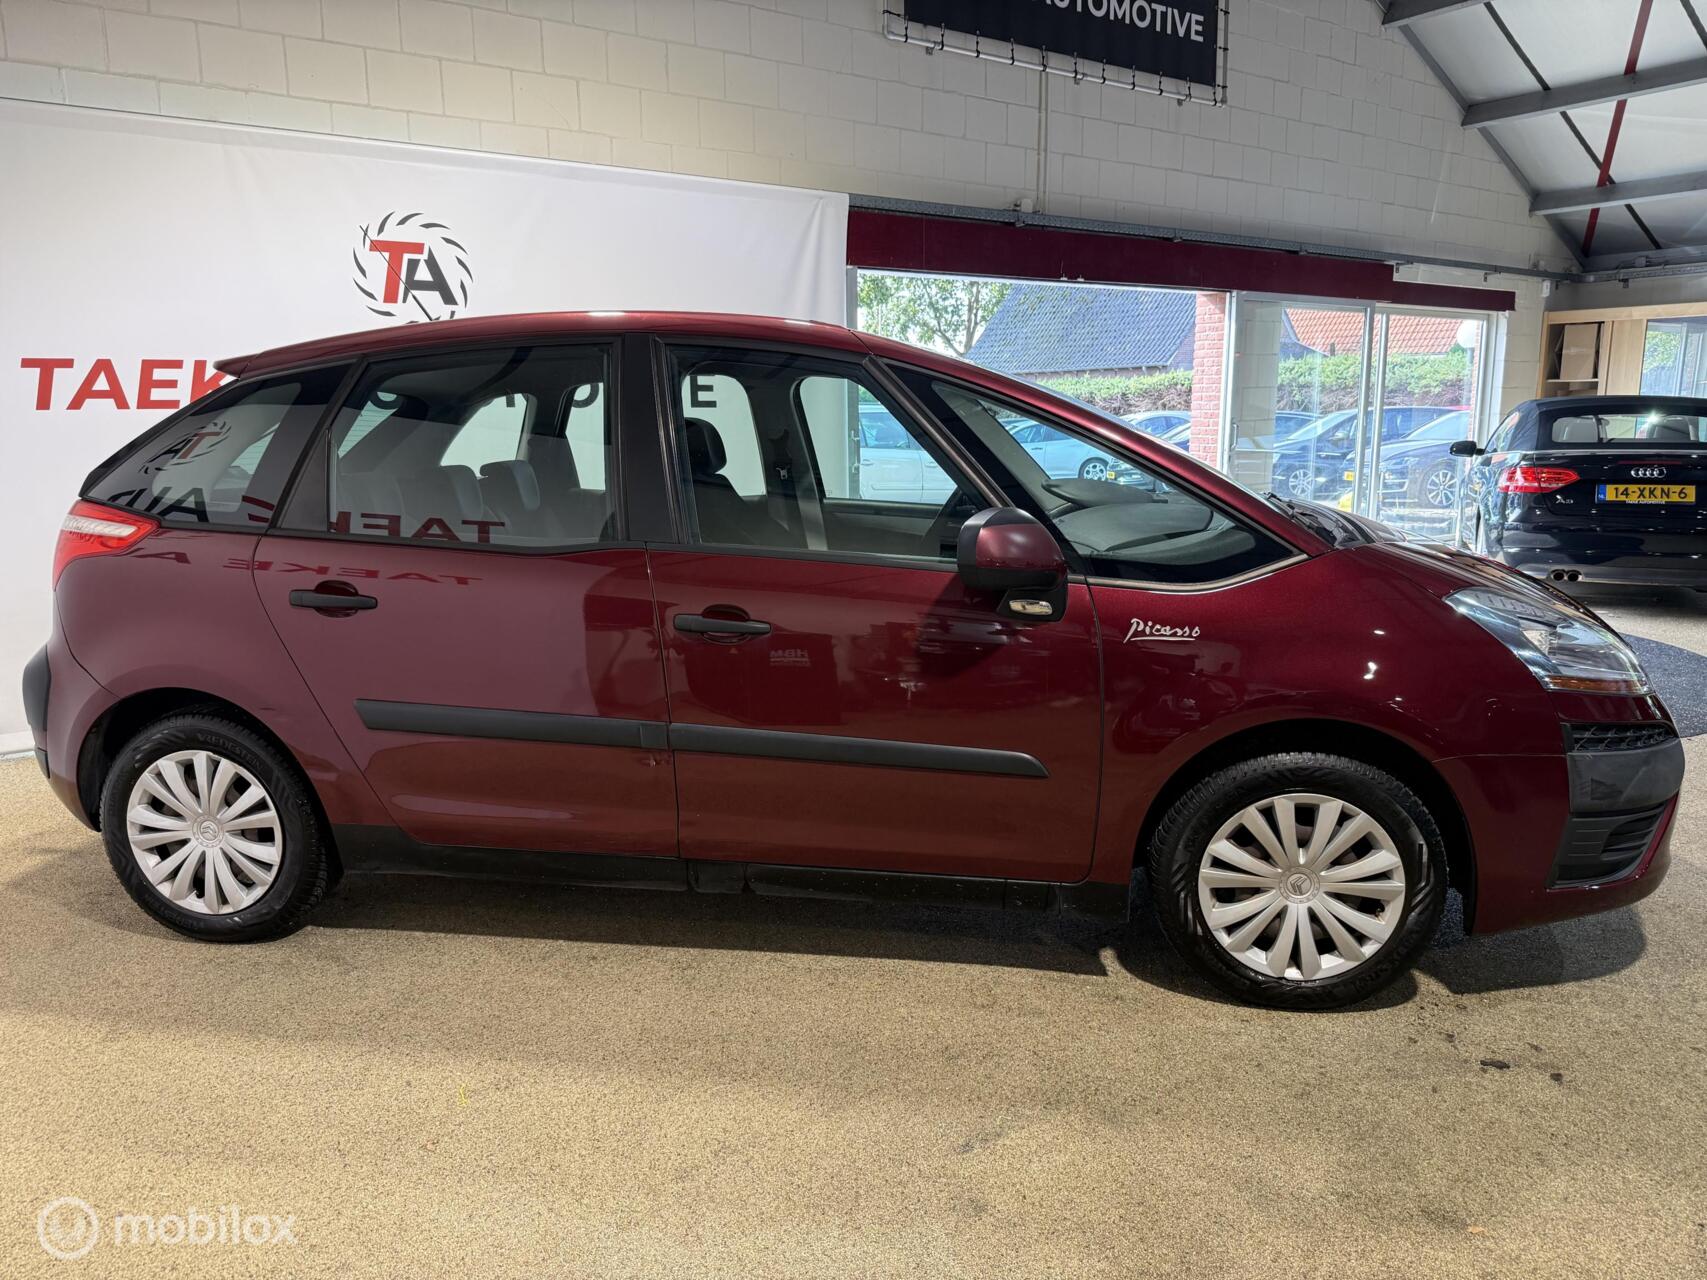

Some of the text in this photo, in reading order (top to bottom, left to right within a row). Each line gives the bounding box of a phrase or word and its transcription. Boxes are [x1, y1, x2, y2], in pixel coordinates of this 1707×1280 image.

[1036, 0, 1204, 42] OMOTIVE
[369, 239, 459, 306] TA
[1613, 487, 1688, 499] 14-XKN-6
[1123, 618, 1200, 643] Picasso
